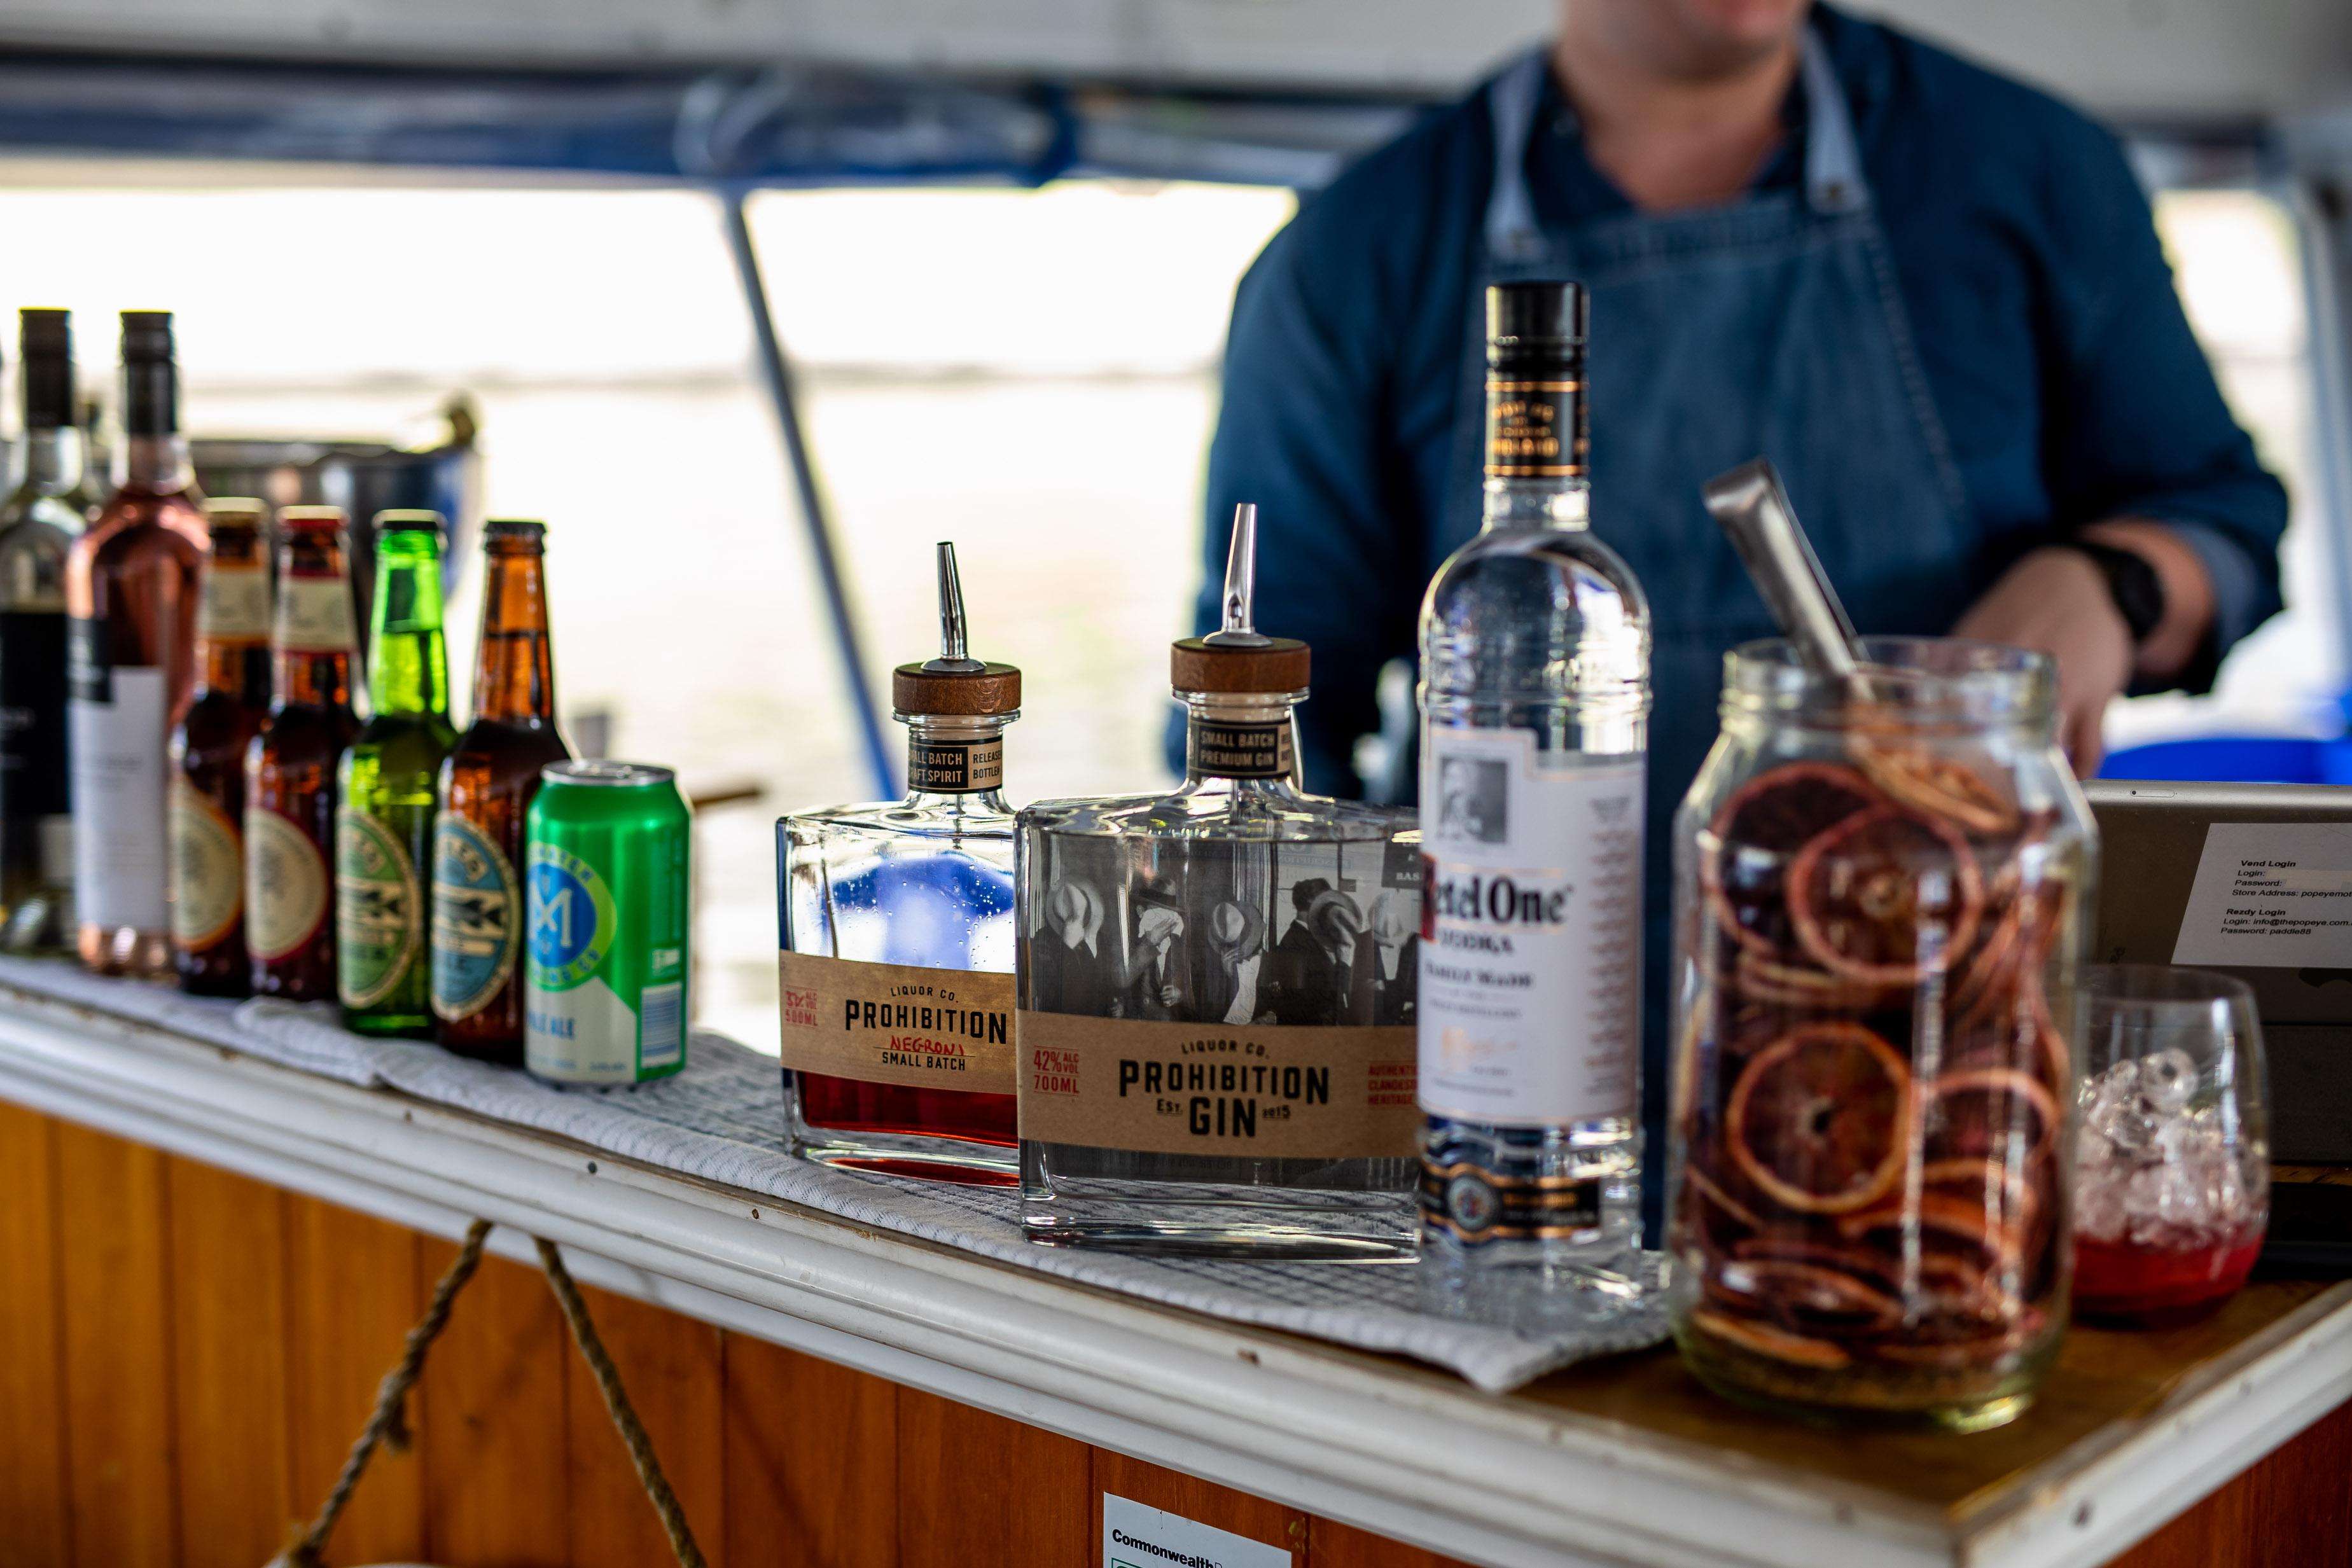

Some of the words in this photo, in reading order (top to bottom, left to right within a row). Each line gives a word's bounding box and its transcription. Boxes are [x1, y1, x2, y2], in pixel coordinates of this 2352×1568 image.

[1238, 732, 1274, 748] BATCH
[929, 753, 963, 765] BATCH
[928, 770, 963, 782] SPIRIT
[1488, 875, 1564, 924] One
[2253, 919, 2352, 927] info@thepopeye.com.
[891, 986, 933, 997] LIQUOR
[940, 989, 959, 1003] CO.
[785, 1009, 818, 1026] 500ML
[845, 999, 1007, 1044] PROHIBITION
[890, 1036, 966, 1057] NEGRONI
[1181, 1039, 1237, 1055] LIQUOR
[1245, 1042, 1270, 1060] CO.
[882, 1051, 921, 1067] SMALL
[927, 1056, 965, 1071] BATCH
[1034, 1050, 1062, 1072] 42%
[1063, 1052, 1080, 1062] ALC
[1063, 1062, 1080, 1074] VOL
[1034, 1074, 1080, 1093] 700ML
[1119, 1058, 1328, 1105] PROHIBITION
[1189, 1096, 1256, 1137] GIN
